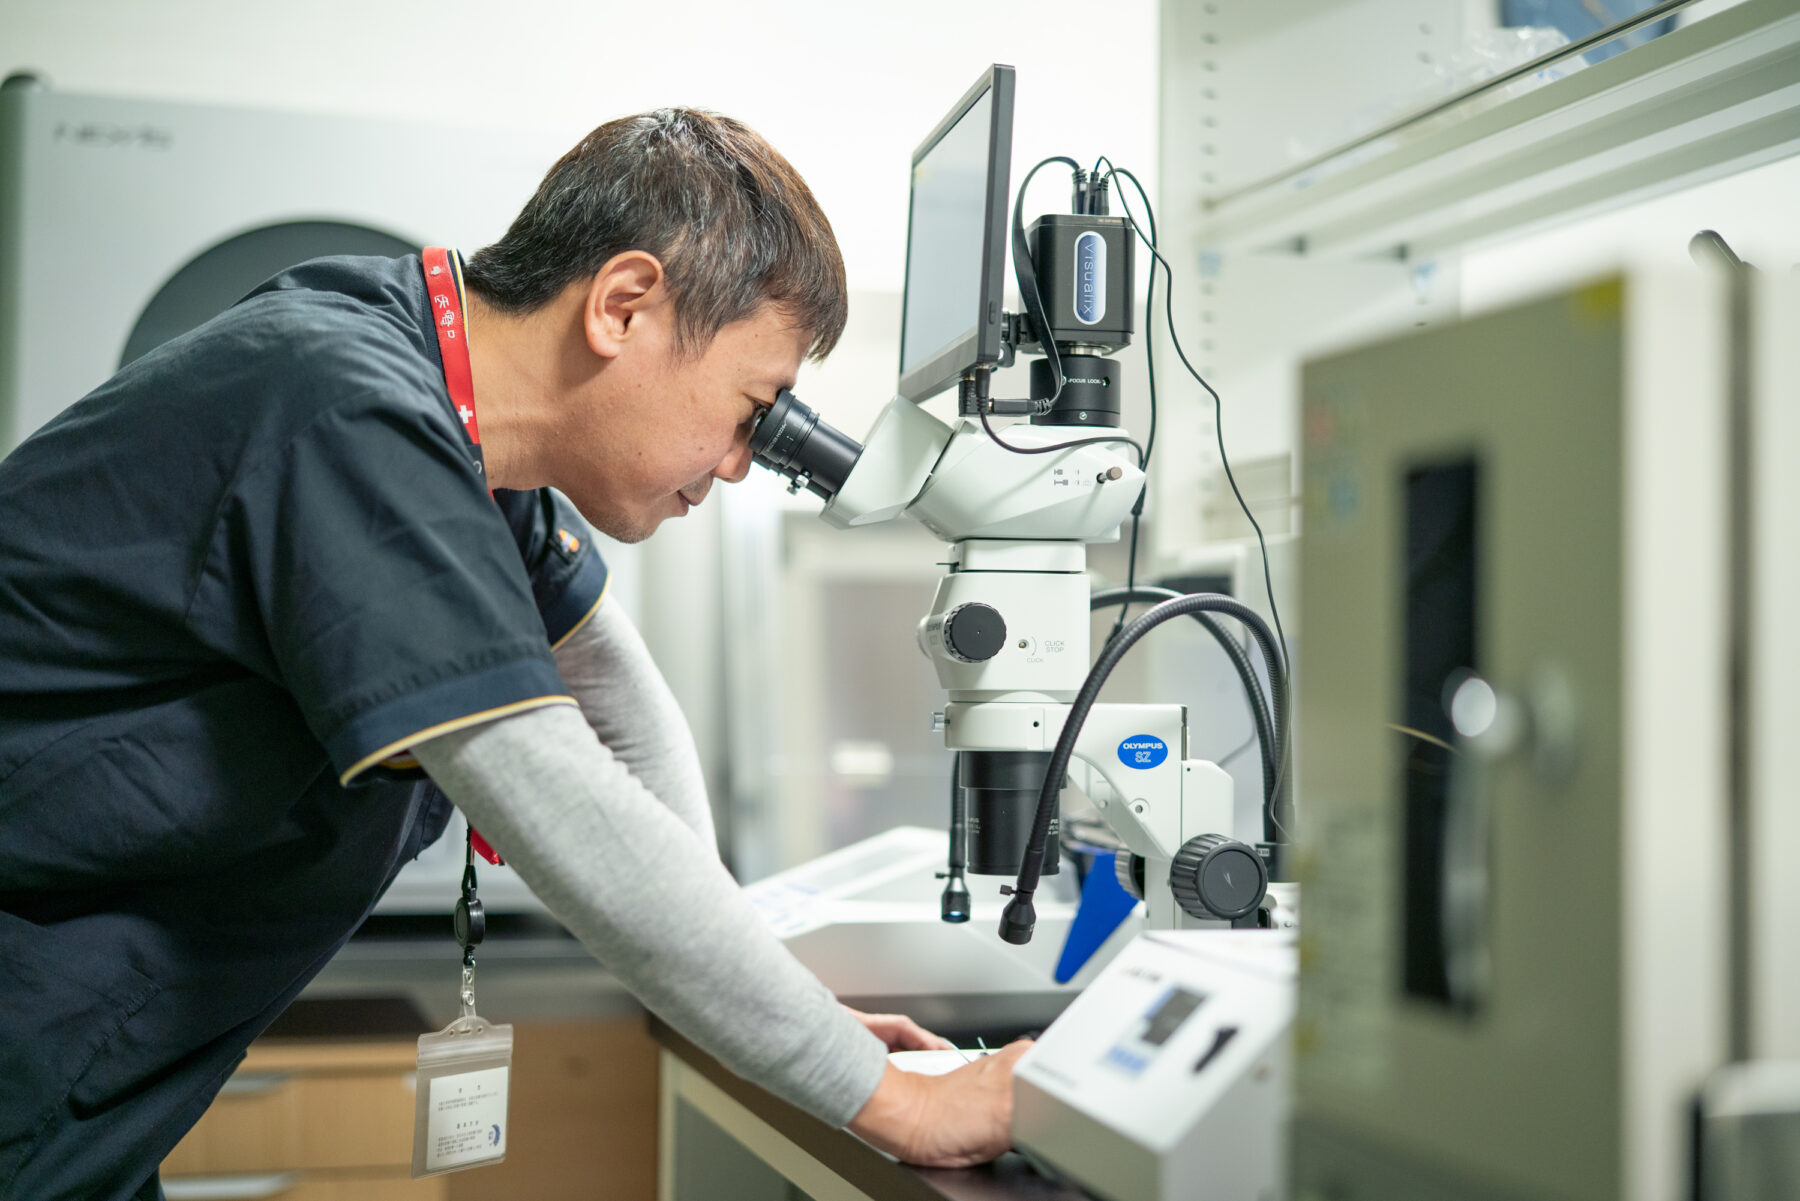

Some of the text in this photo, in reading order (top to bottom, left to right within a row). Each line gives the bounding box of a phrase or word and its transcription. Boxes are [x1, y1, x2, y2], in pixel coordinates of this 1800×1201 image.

[1083, 242, 1097, 314] Visualix
[1122, 742, 1163, 750] OLYMPUS
[1135, 751, 1151, 762] SZ
